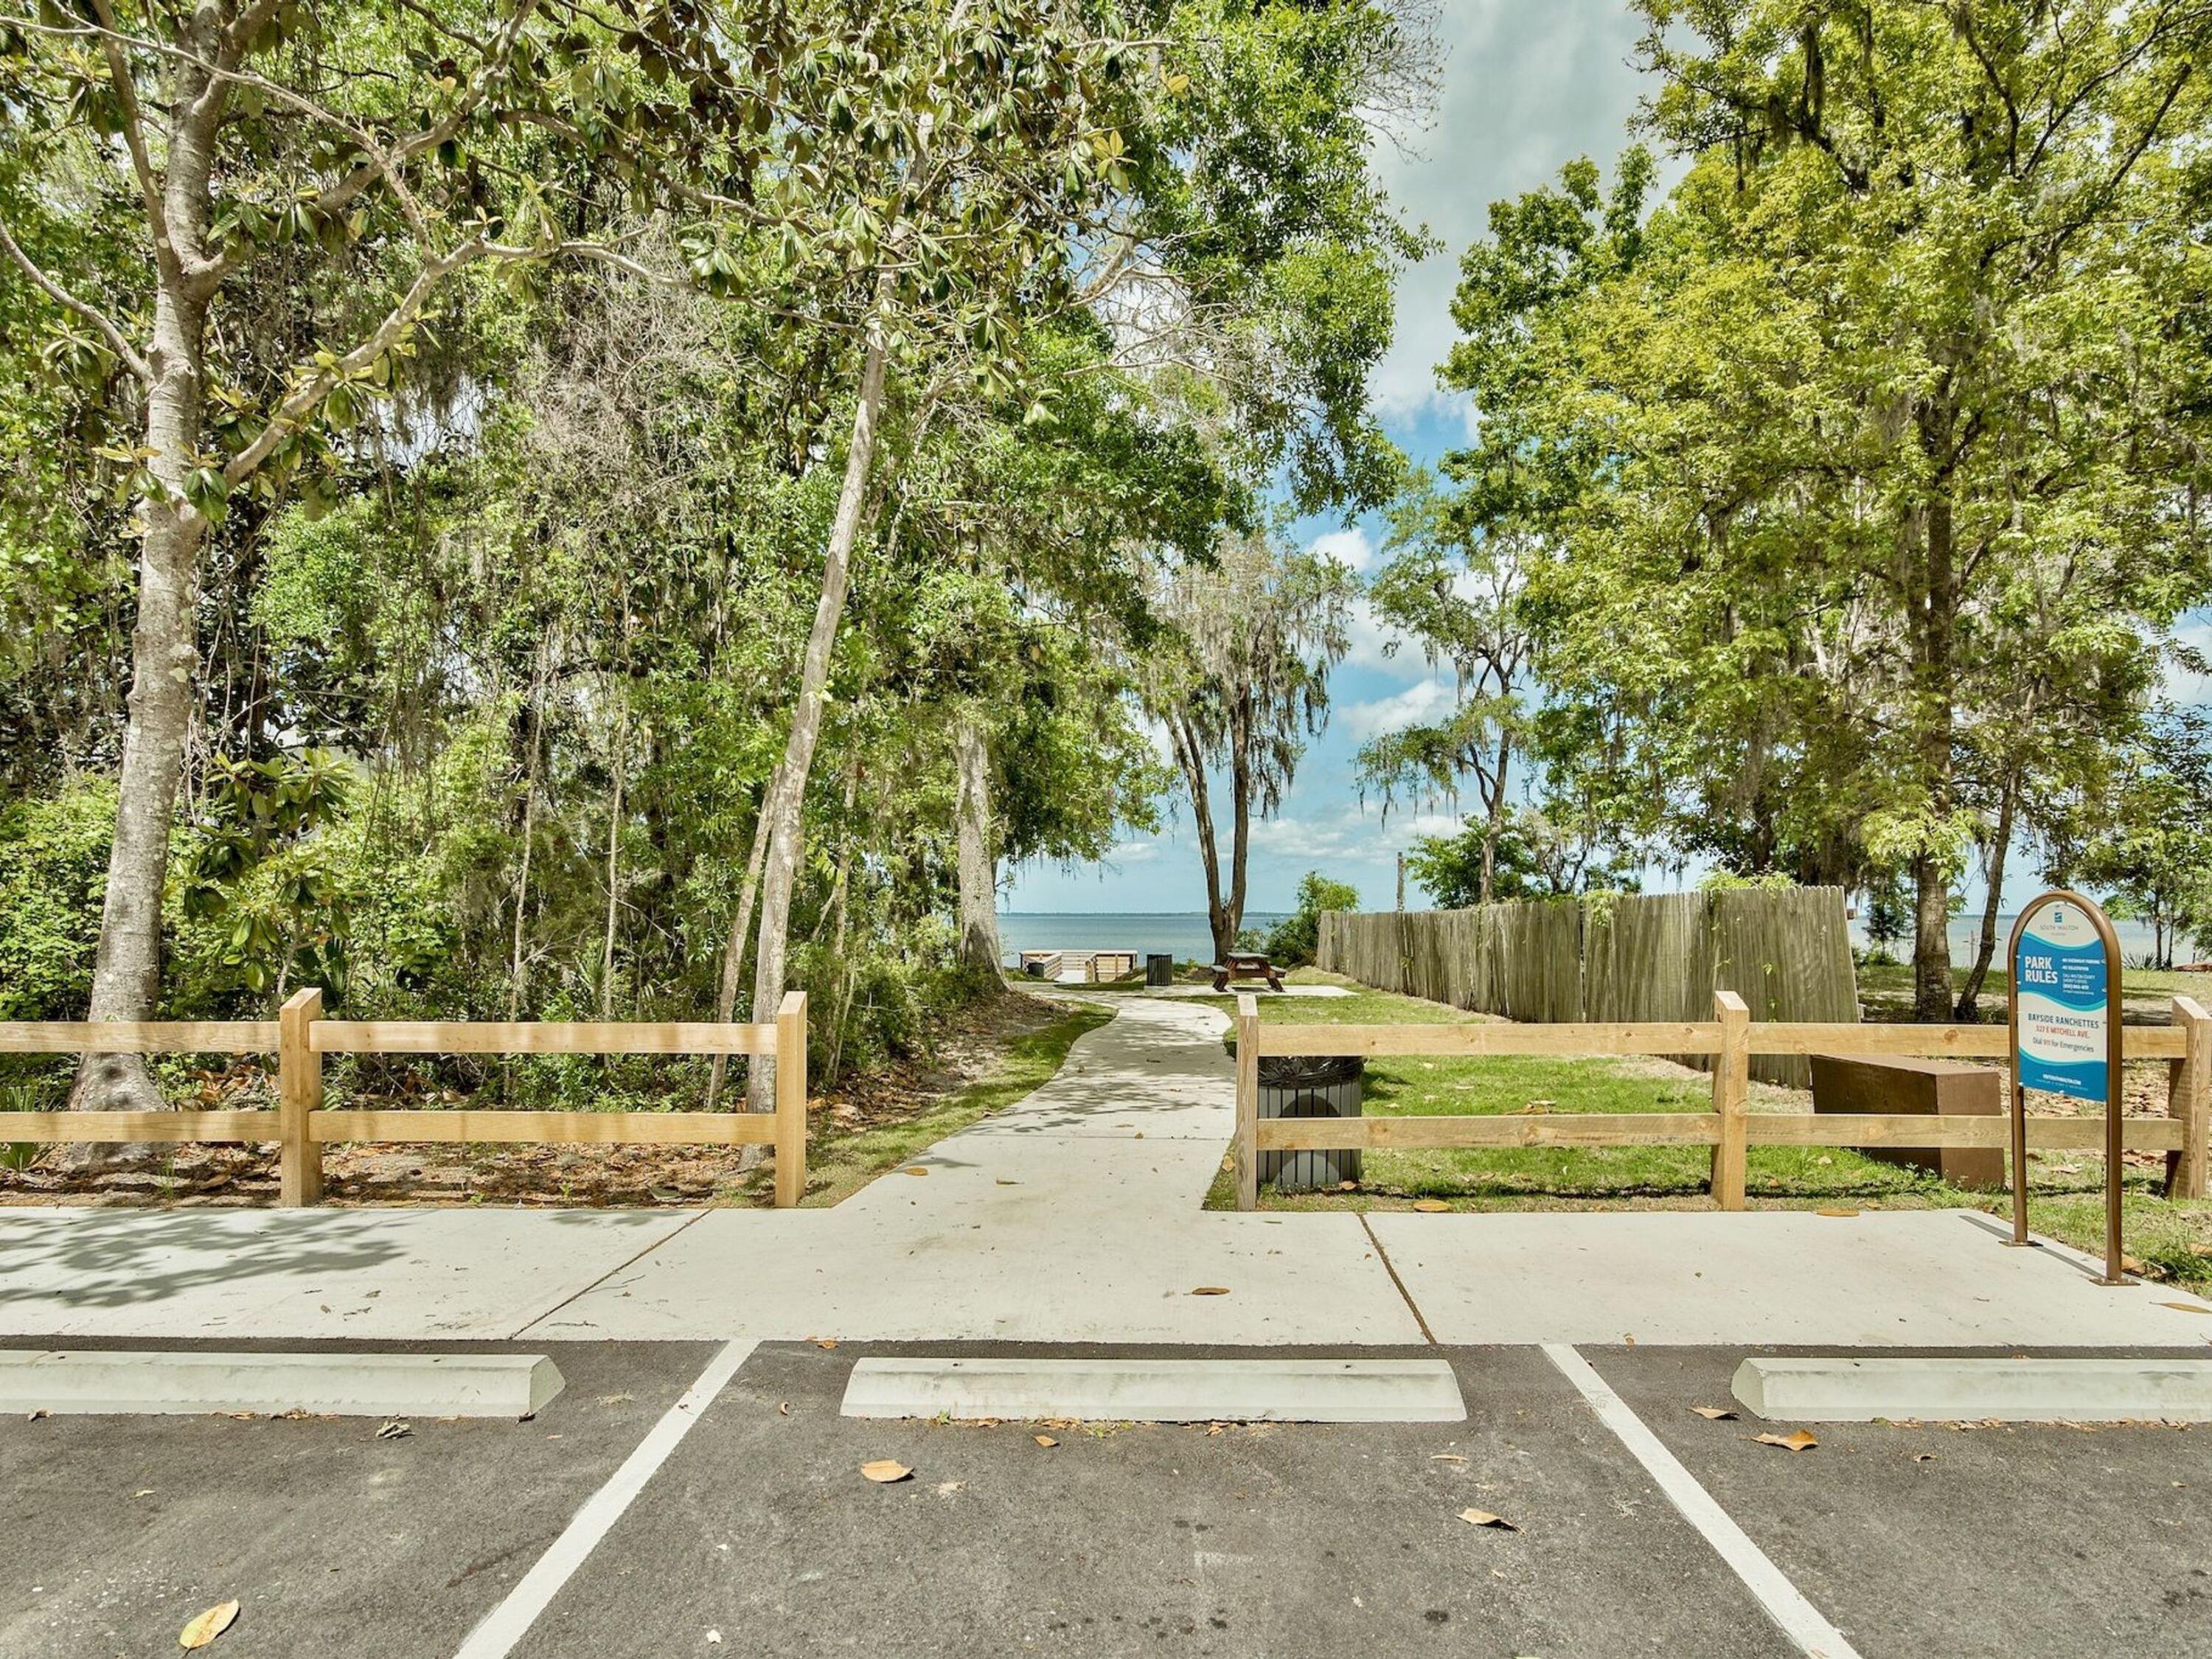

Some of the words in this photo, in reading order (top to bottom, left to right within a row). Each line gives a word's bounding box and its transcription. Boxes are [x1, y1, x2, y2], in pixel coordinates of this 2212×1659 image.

[2025, 956, 2052, 970] PARK
[2025, 970, 2058, 984] RULES
[2028, 1013, 2053, 1023] BAYSIDE
[2056, 1016, 2099, 1029] RANCHETTES
[2051, 1026, 2076, 1036] MITCHELL
[2060, 1040, 2094, 1052] Emergencies
